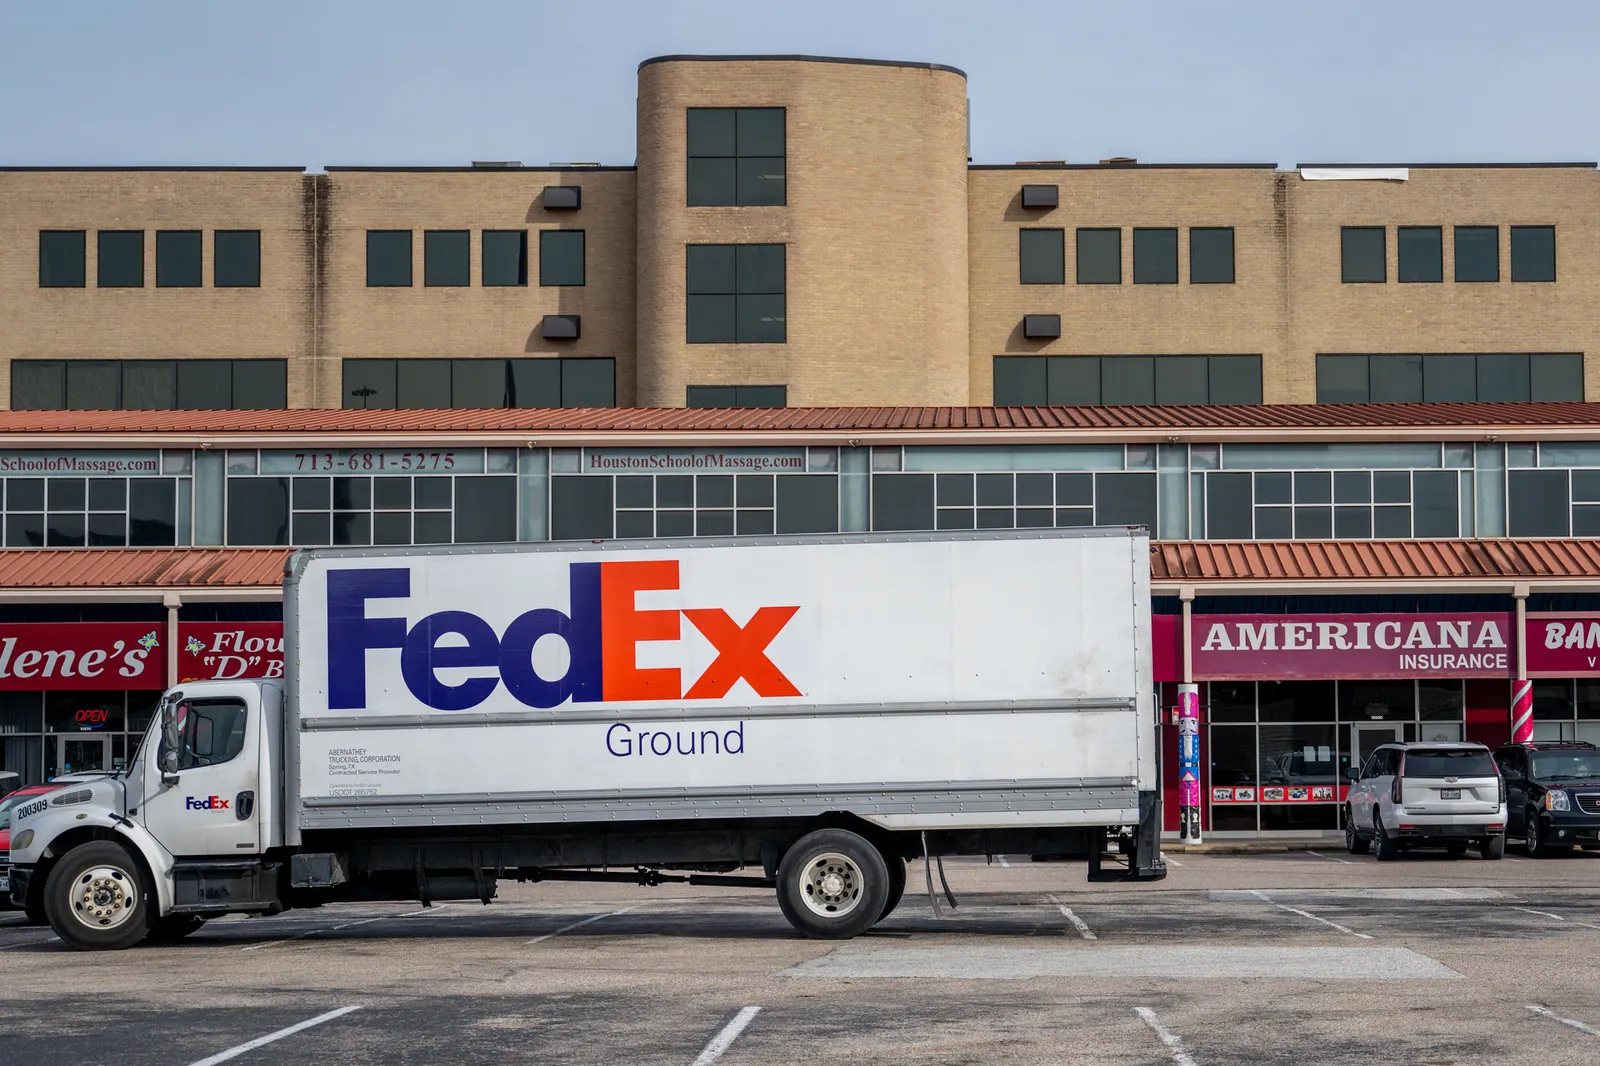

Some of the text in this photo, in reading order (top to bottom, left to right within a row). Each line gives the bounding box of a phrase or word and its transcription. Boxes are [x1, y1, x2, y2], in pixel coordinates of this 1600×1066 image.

[0, 456, 157, 474] SchoolofMassage.com
[294, 452, 455, 471] 713-681-5275
[590, 452, 803, 471] HoustonSchoolofMassage.com
[326, 559, 804, 711] FedEx
[1200, 620, 1508, 651] AMERICANA
[1399, 652, 1508, 670] INSURANCE
[75, 709, 109, 722] OPEN
[606, 720, 745, 757] Ground
[328, 748, 367, 756] ABERNATHEY
[359, 755, 401, 763] CORPORATION
[328, 789, 352, 797] USDOT
[17, 799, 48, 820] 200309
[185, 795, 230, 811] FedEx
